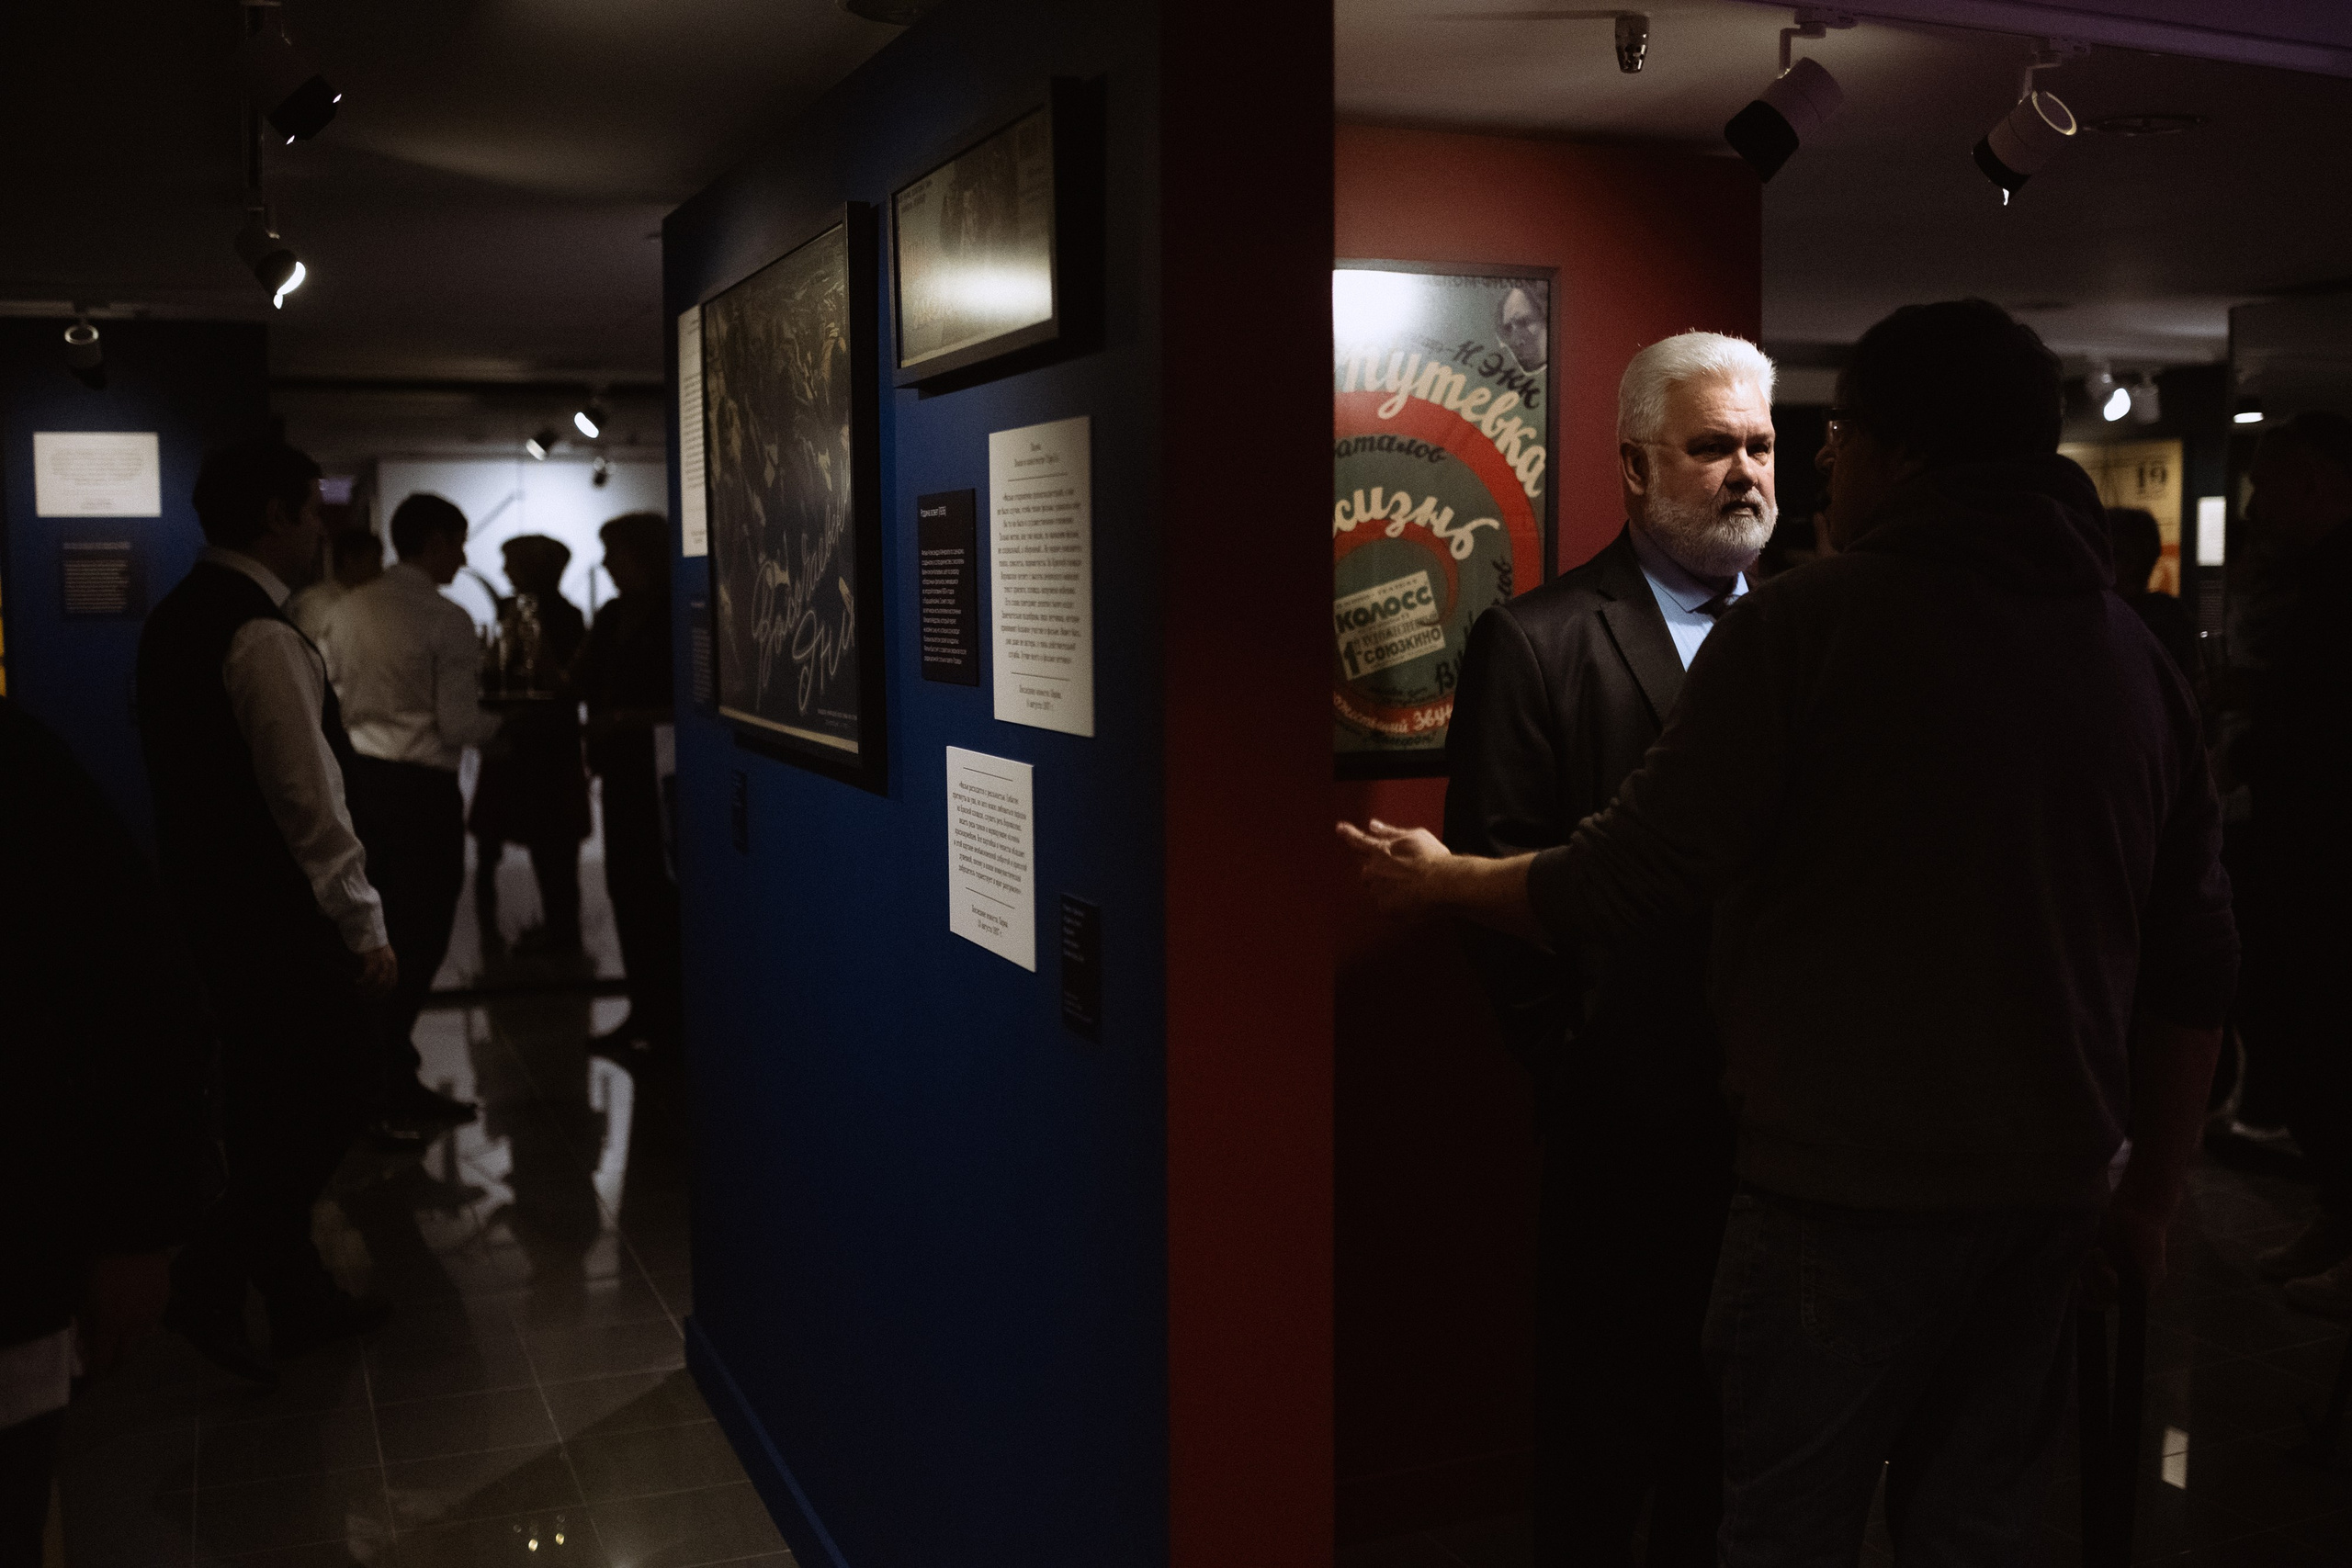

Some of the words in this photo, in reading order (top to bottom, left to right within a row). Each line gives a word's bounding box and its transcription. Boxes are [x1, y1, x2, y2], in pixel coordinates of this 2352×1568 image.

[1333, 434, 1446, 463] аталов
[1335, 585, 1432, 634] КОЛОСС
[1363, 627, 1442, 664] СОЮЗКИНО
